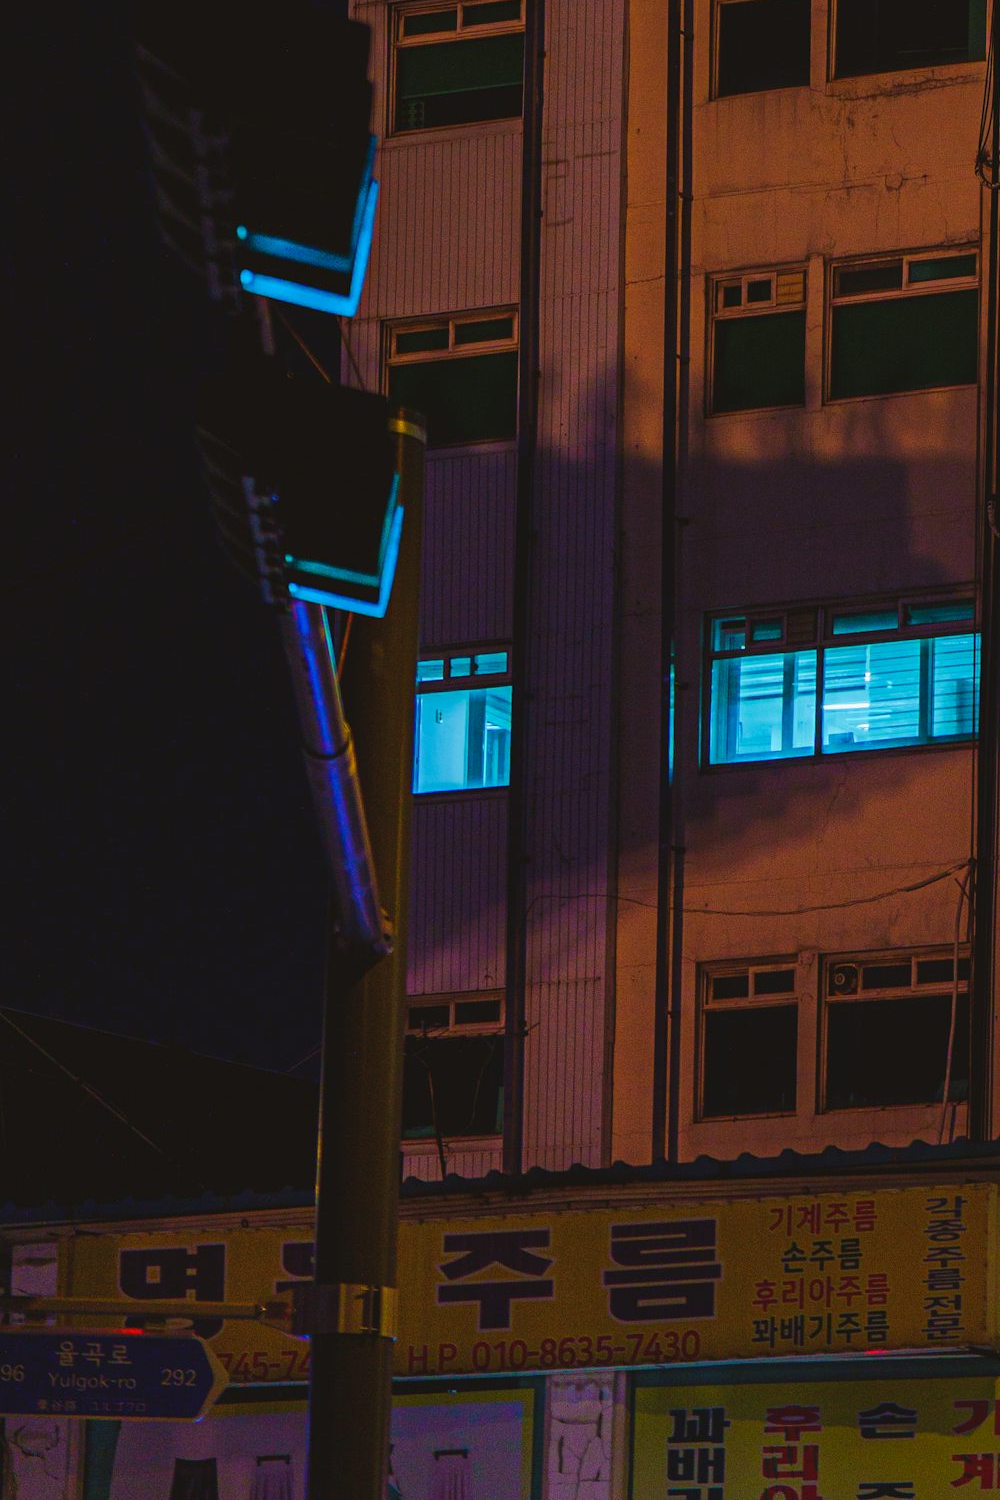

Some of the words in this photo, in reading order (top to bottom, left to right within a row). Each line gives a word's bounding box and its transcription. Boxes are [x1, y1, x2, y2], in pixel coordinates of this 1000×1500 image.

[768, 1199, 878, 1237] 기계주름
[781, 1238, 863, 1273] 손주름
[922, 1195, 967, 1342] 각종주름전문
[752, 1273, 891, 1312] 후리아주름
[54, 1340, 134, 1368] 율곡로
[471, 1329, 702, 1371] 010-8635-7430
[47, 1371, 138, 1392] Yulgok-ro
[160, 1368, 198, 1388] 292
